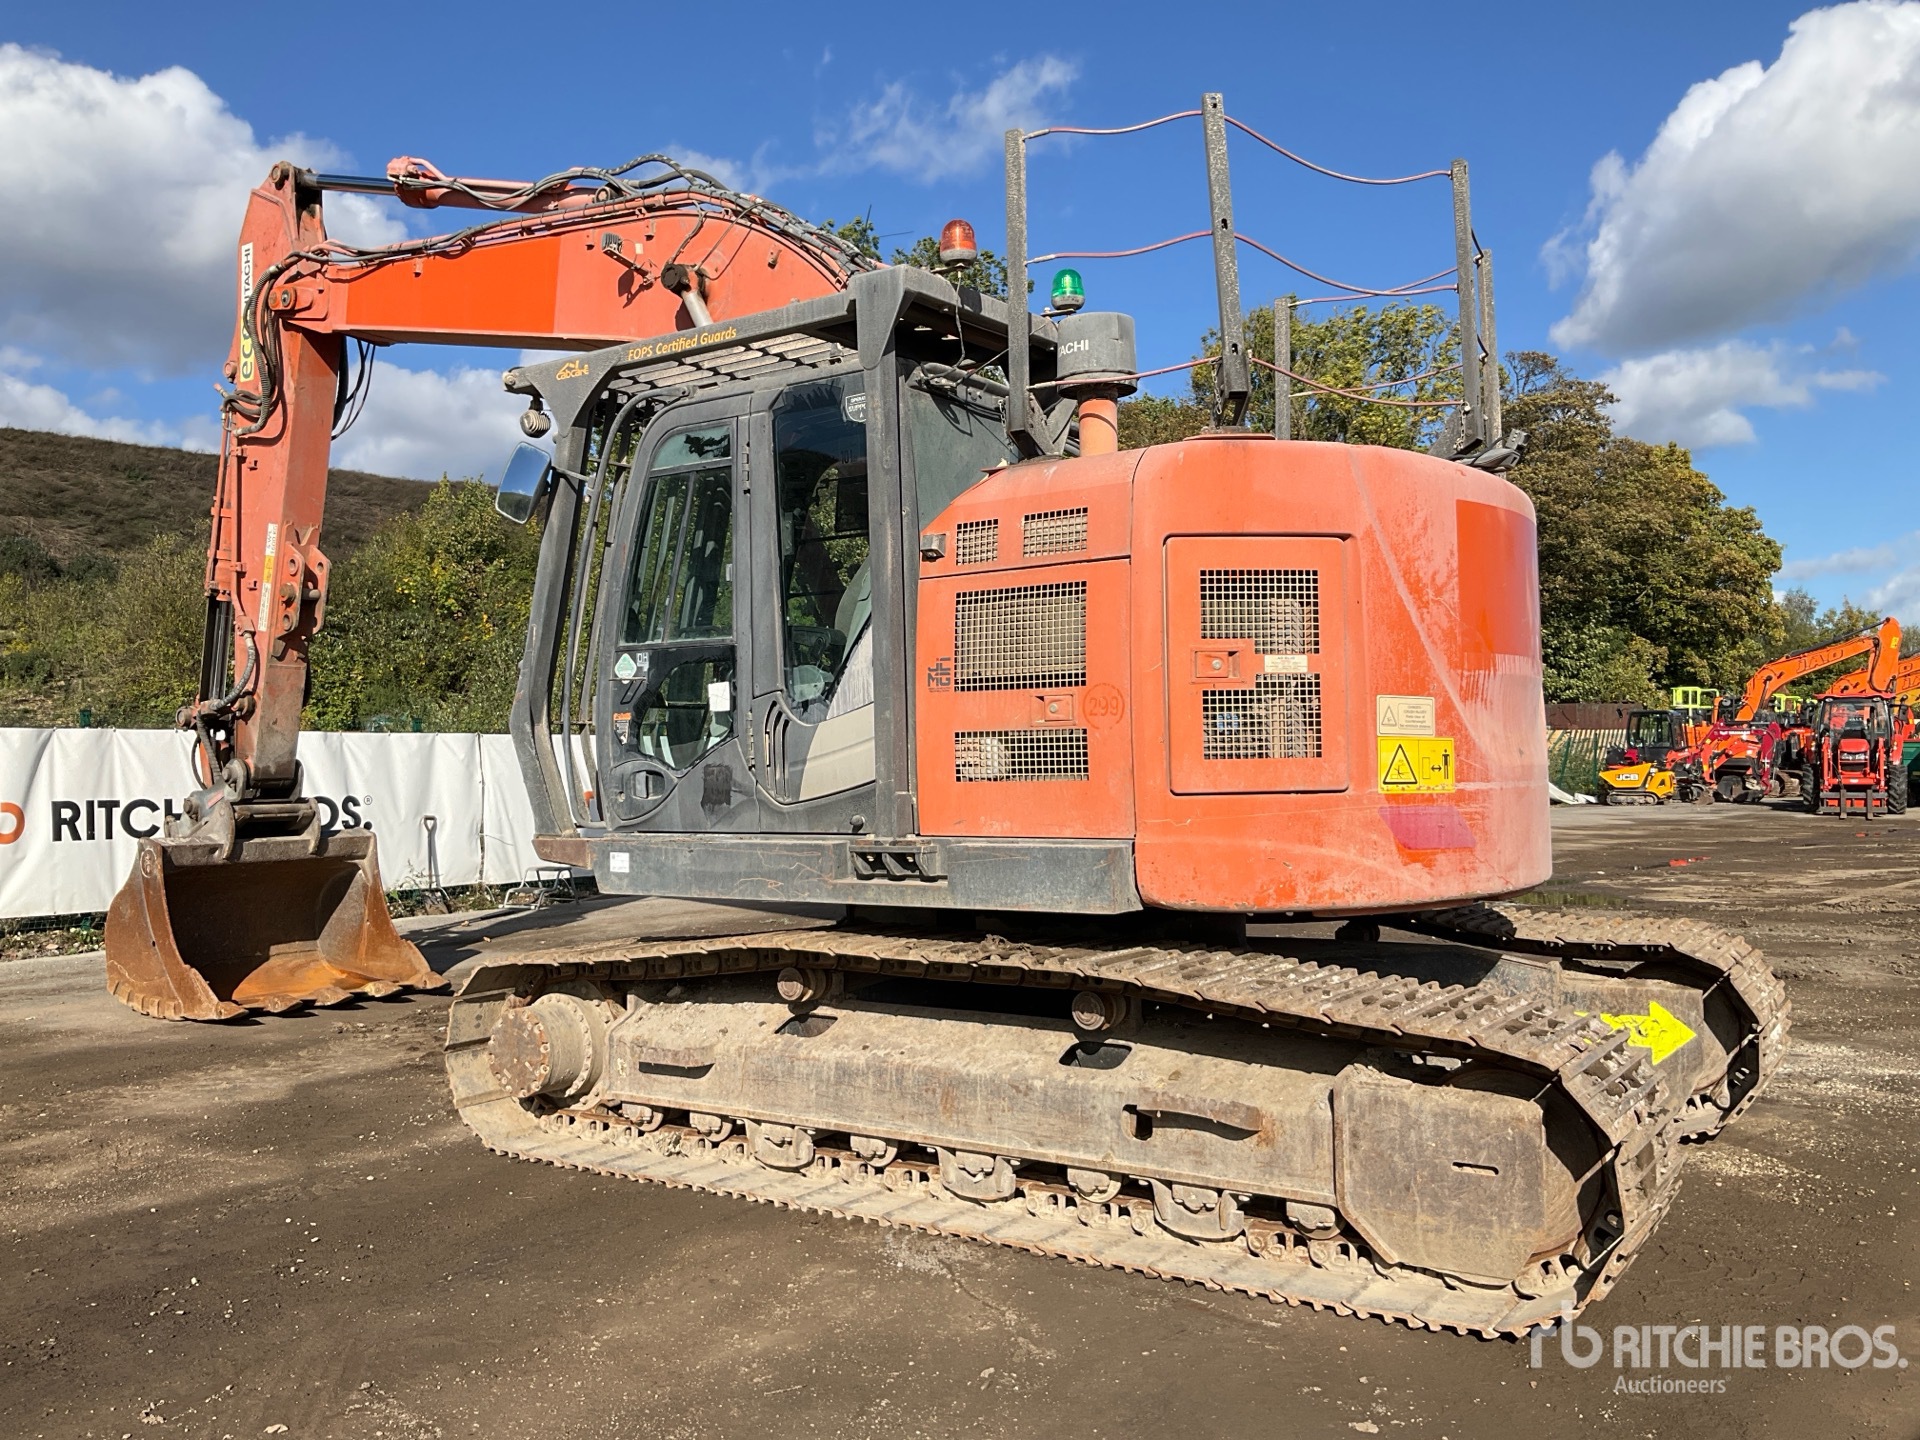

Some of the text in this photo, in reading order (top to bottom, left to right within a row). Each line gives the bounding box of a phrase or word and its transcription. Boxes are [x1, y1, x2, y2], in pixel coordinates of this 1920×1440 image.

[628, 326, 737, 361] FOPS Certified Guards
[1089, 696, 1119, 717] 299
[1616, 773, 1639, 781] JCB
